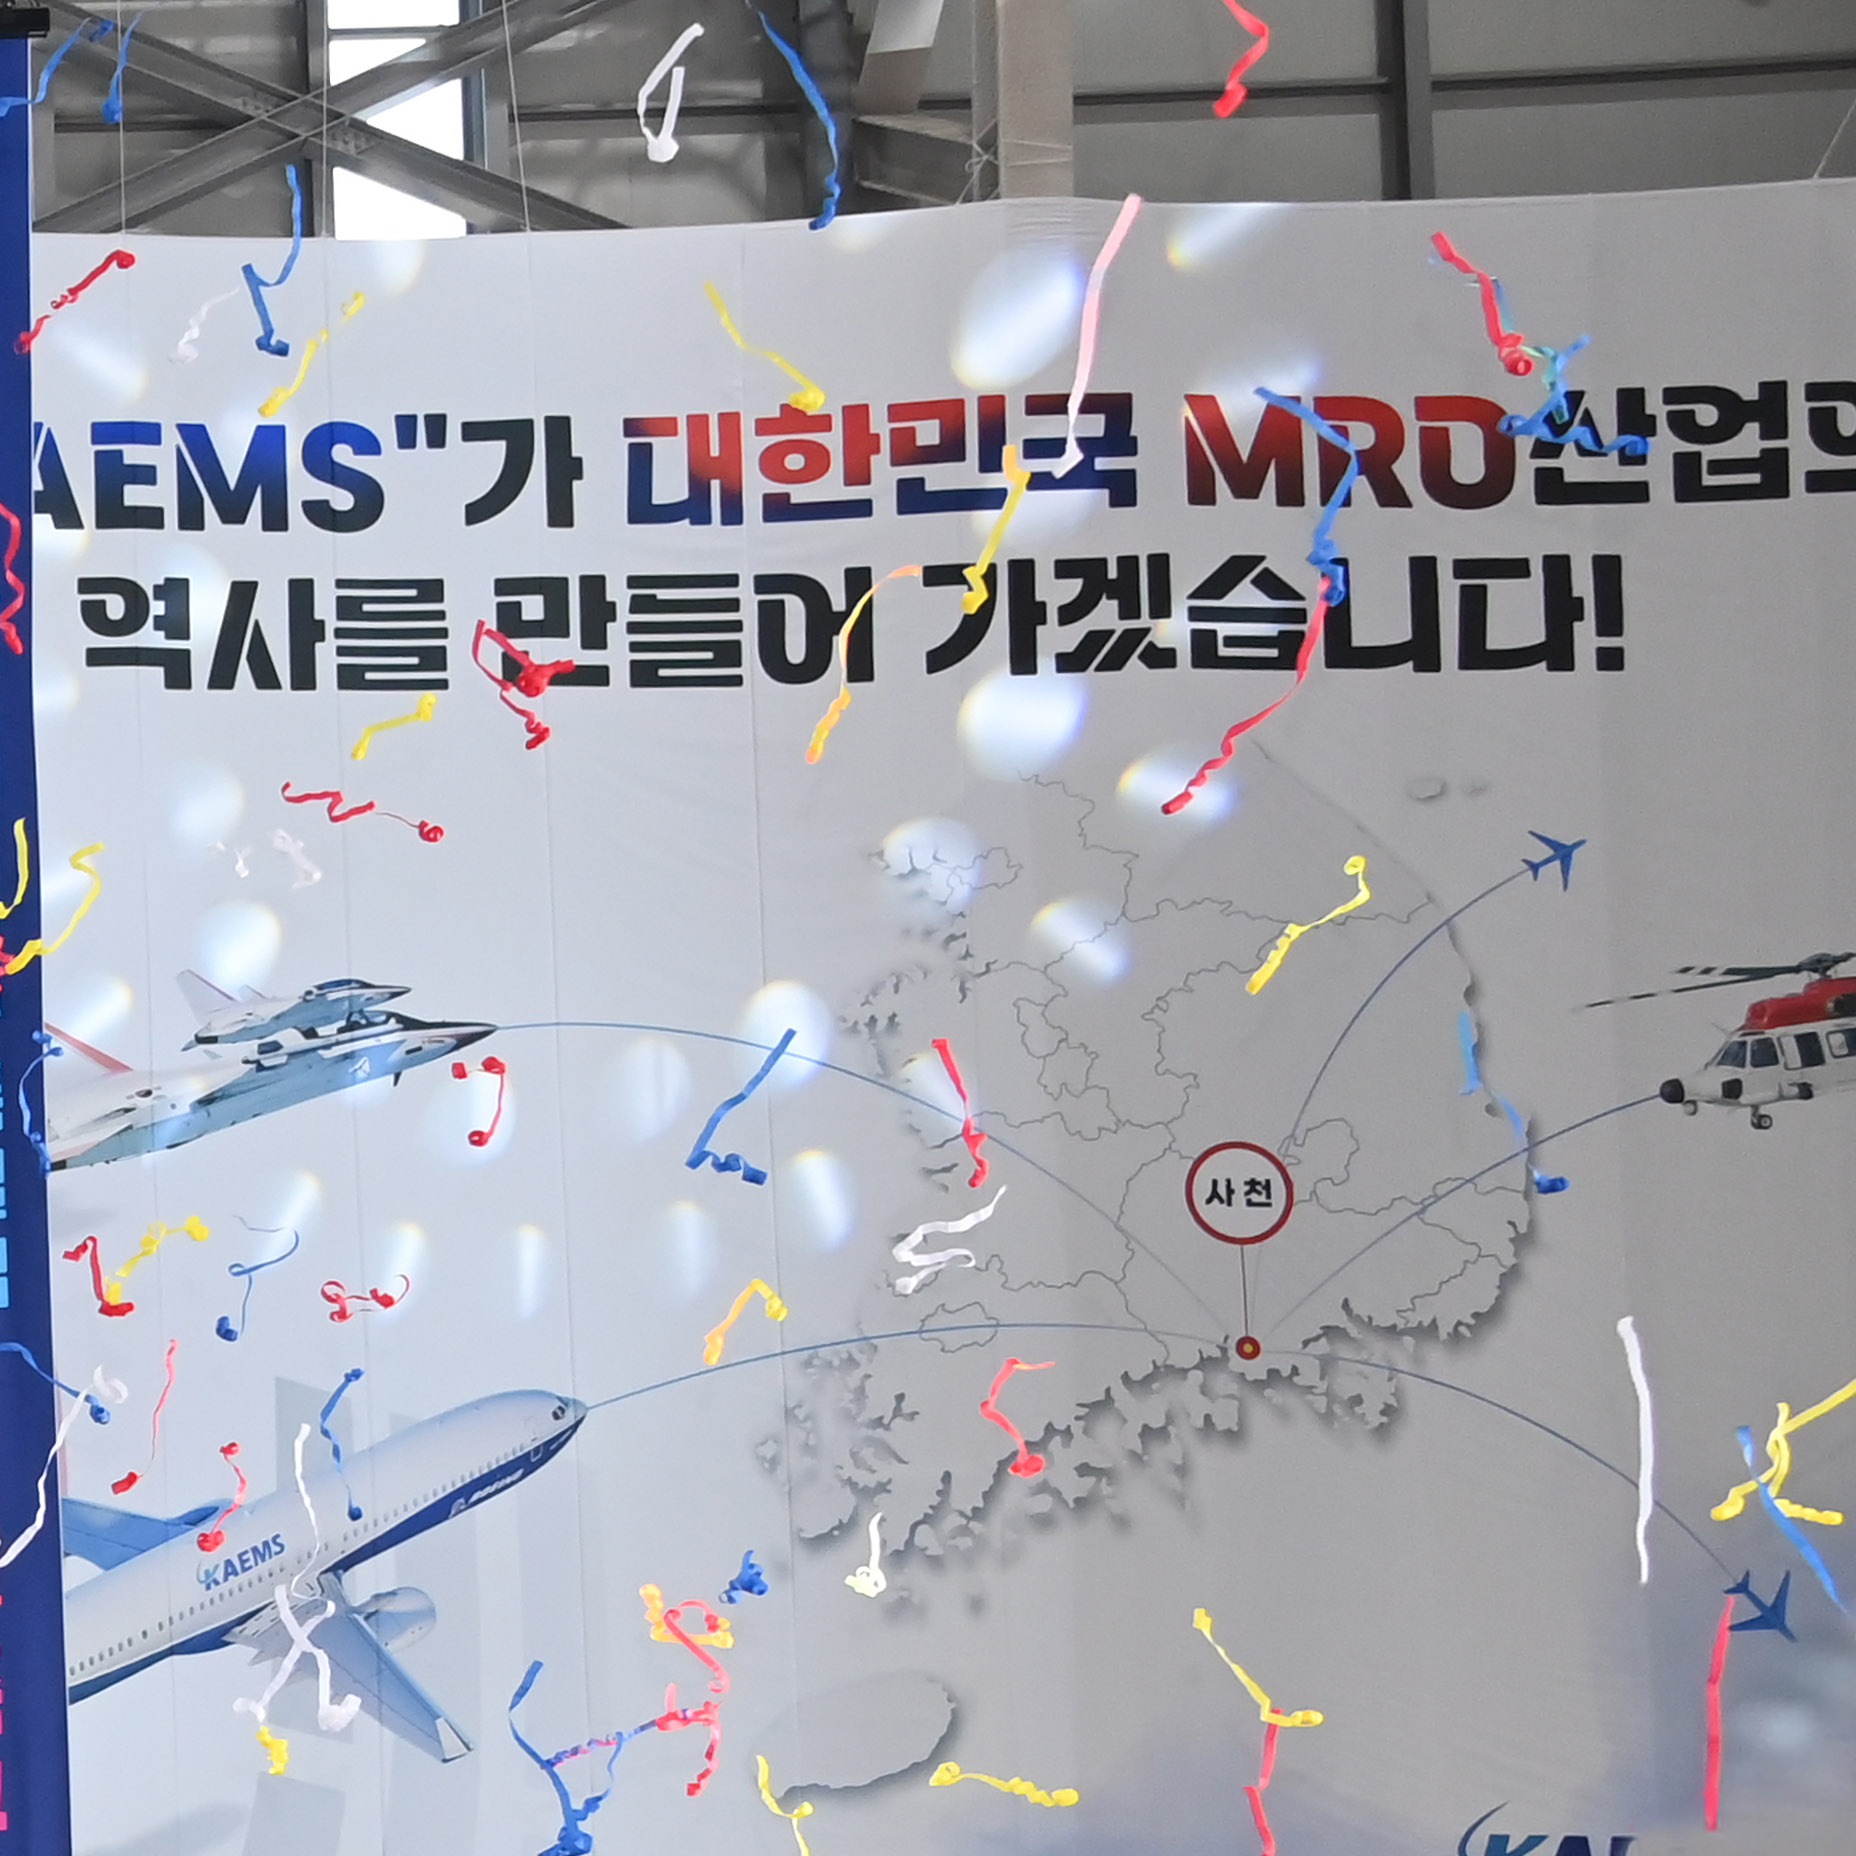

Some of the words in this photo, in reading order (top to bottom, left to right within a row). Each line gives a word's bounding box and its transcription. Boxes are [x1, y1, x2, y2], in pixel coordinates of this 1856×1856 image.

[622, 392, 1137, 525] 대한민국
[77, 577, 449, 691] 역사를
[494, 566, 874, 689] 만들어
[921, 552, 1626, 676] 가겠습니다!
[1205, 1178, 1273, 1207] 사천
[196, 1533, 286, 1592] KAEMS
